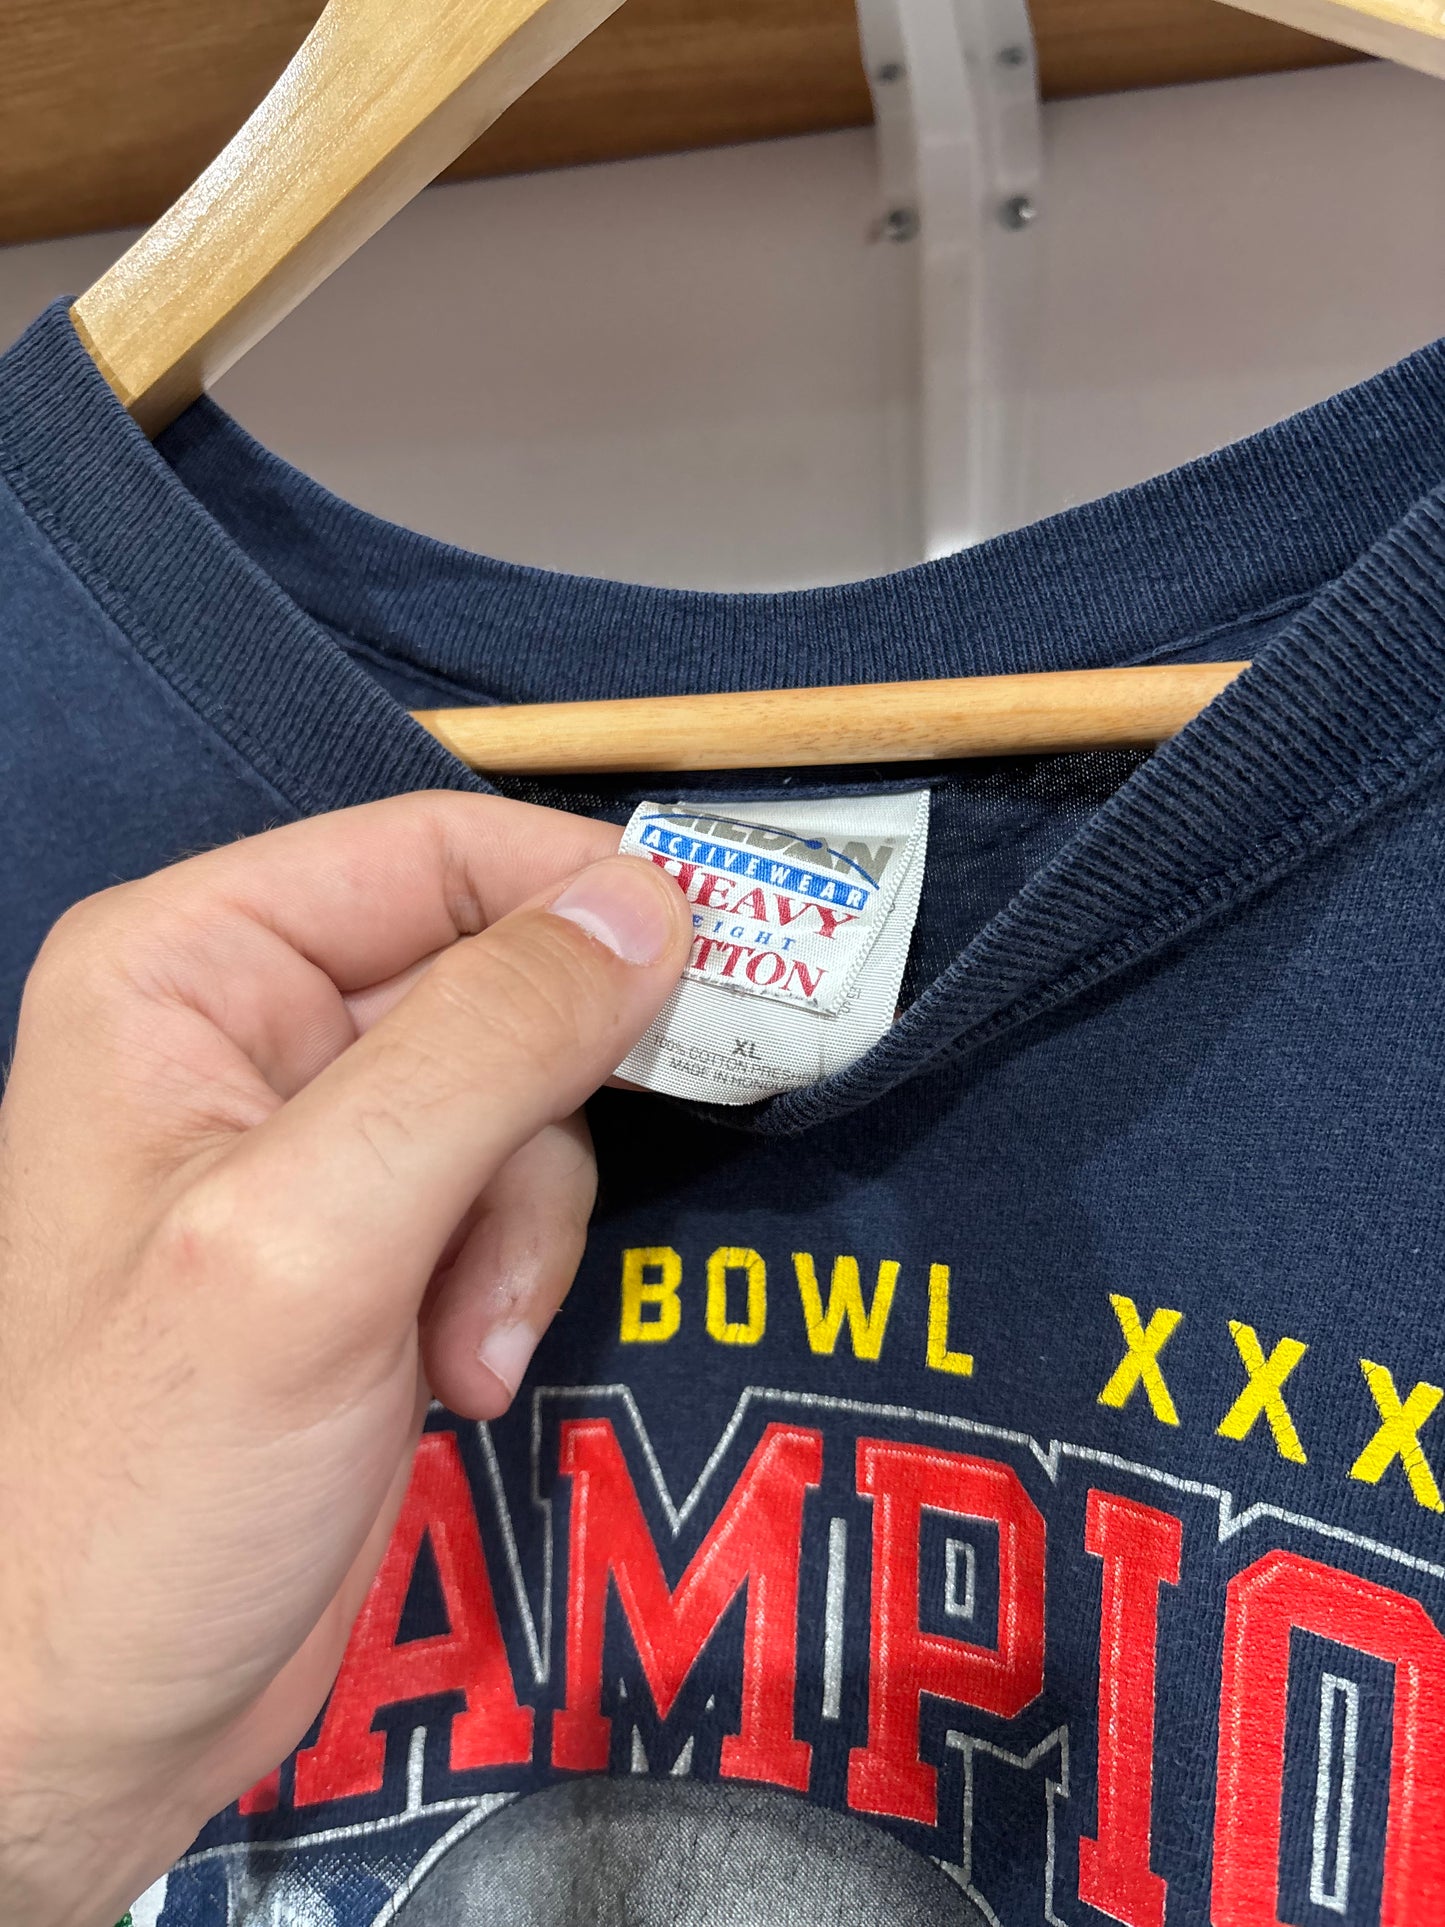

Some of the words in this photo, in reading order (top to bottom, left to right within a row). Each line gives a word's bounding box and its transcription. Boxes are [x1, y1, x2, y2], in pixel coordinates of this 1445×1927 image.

[645, 827, 867, 909] ACTIVEWEAR
[691, 913, 797, 951] EIGHT
[689, 934, 829, 998] TTON
[669, 1057, 710, 1080] MADE
[713, 1071, 728, 1085] IN
[689, 1046, 748, 1074] COTTON
[731, 1036, 762, 1061] XL
[620, 1245, 974, 1377] BOWL
[238, 1418, 1445, 1927] AMPIO
